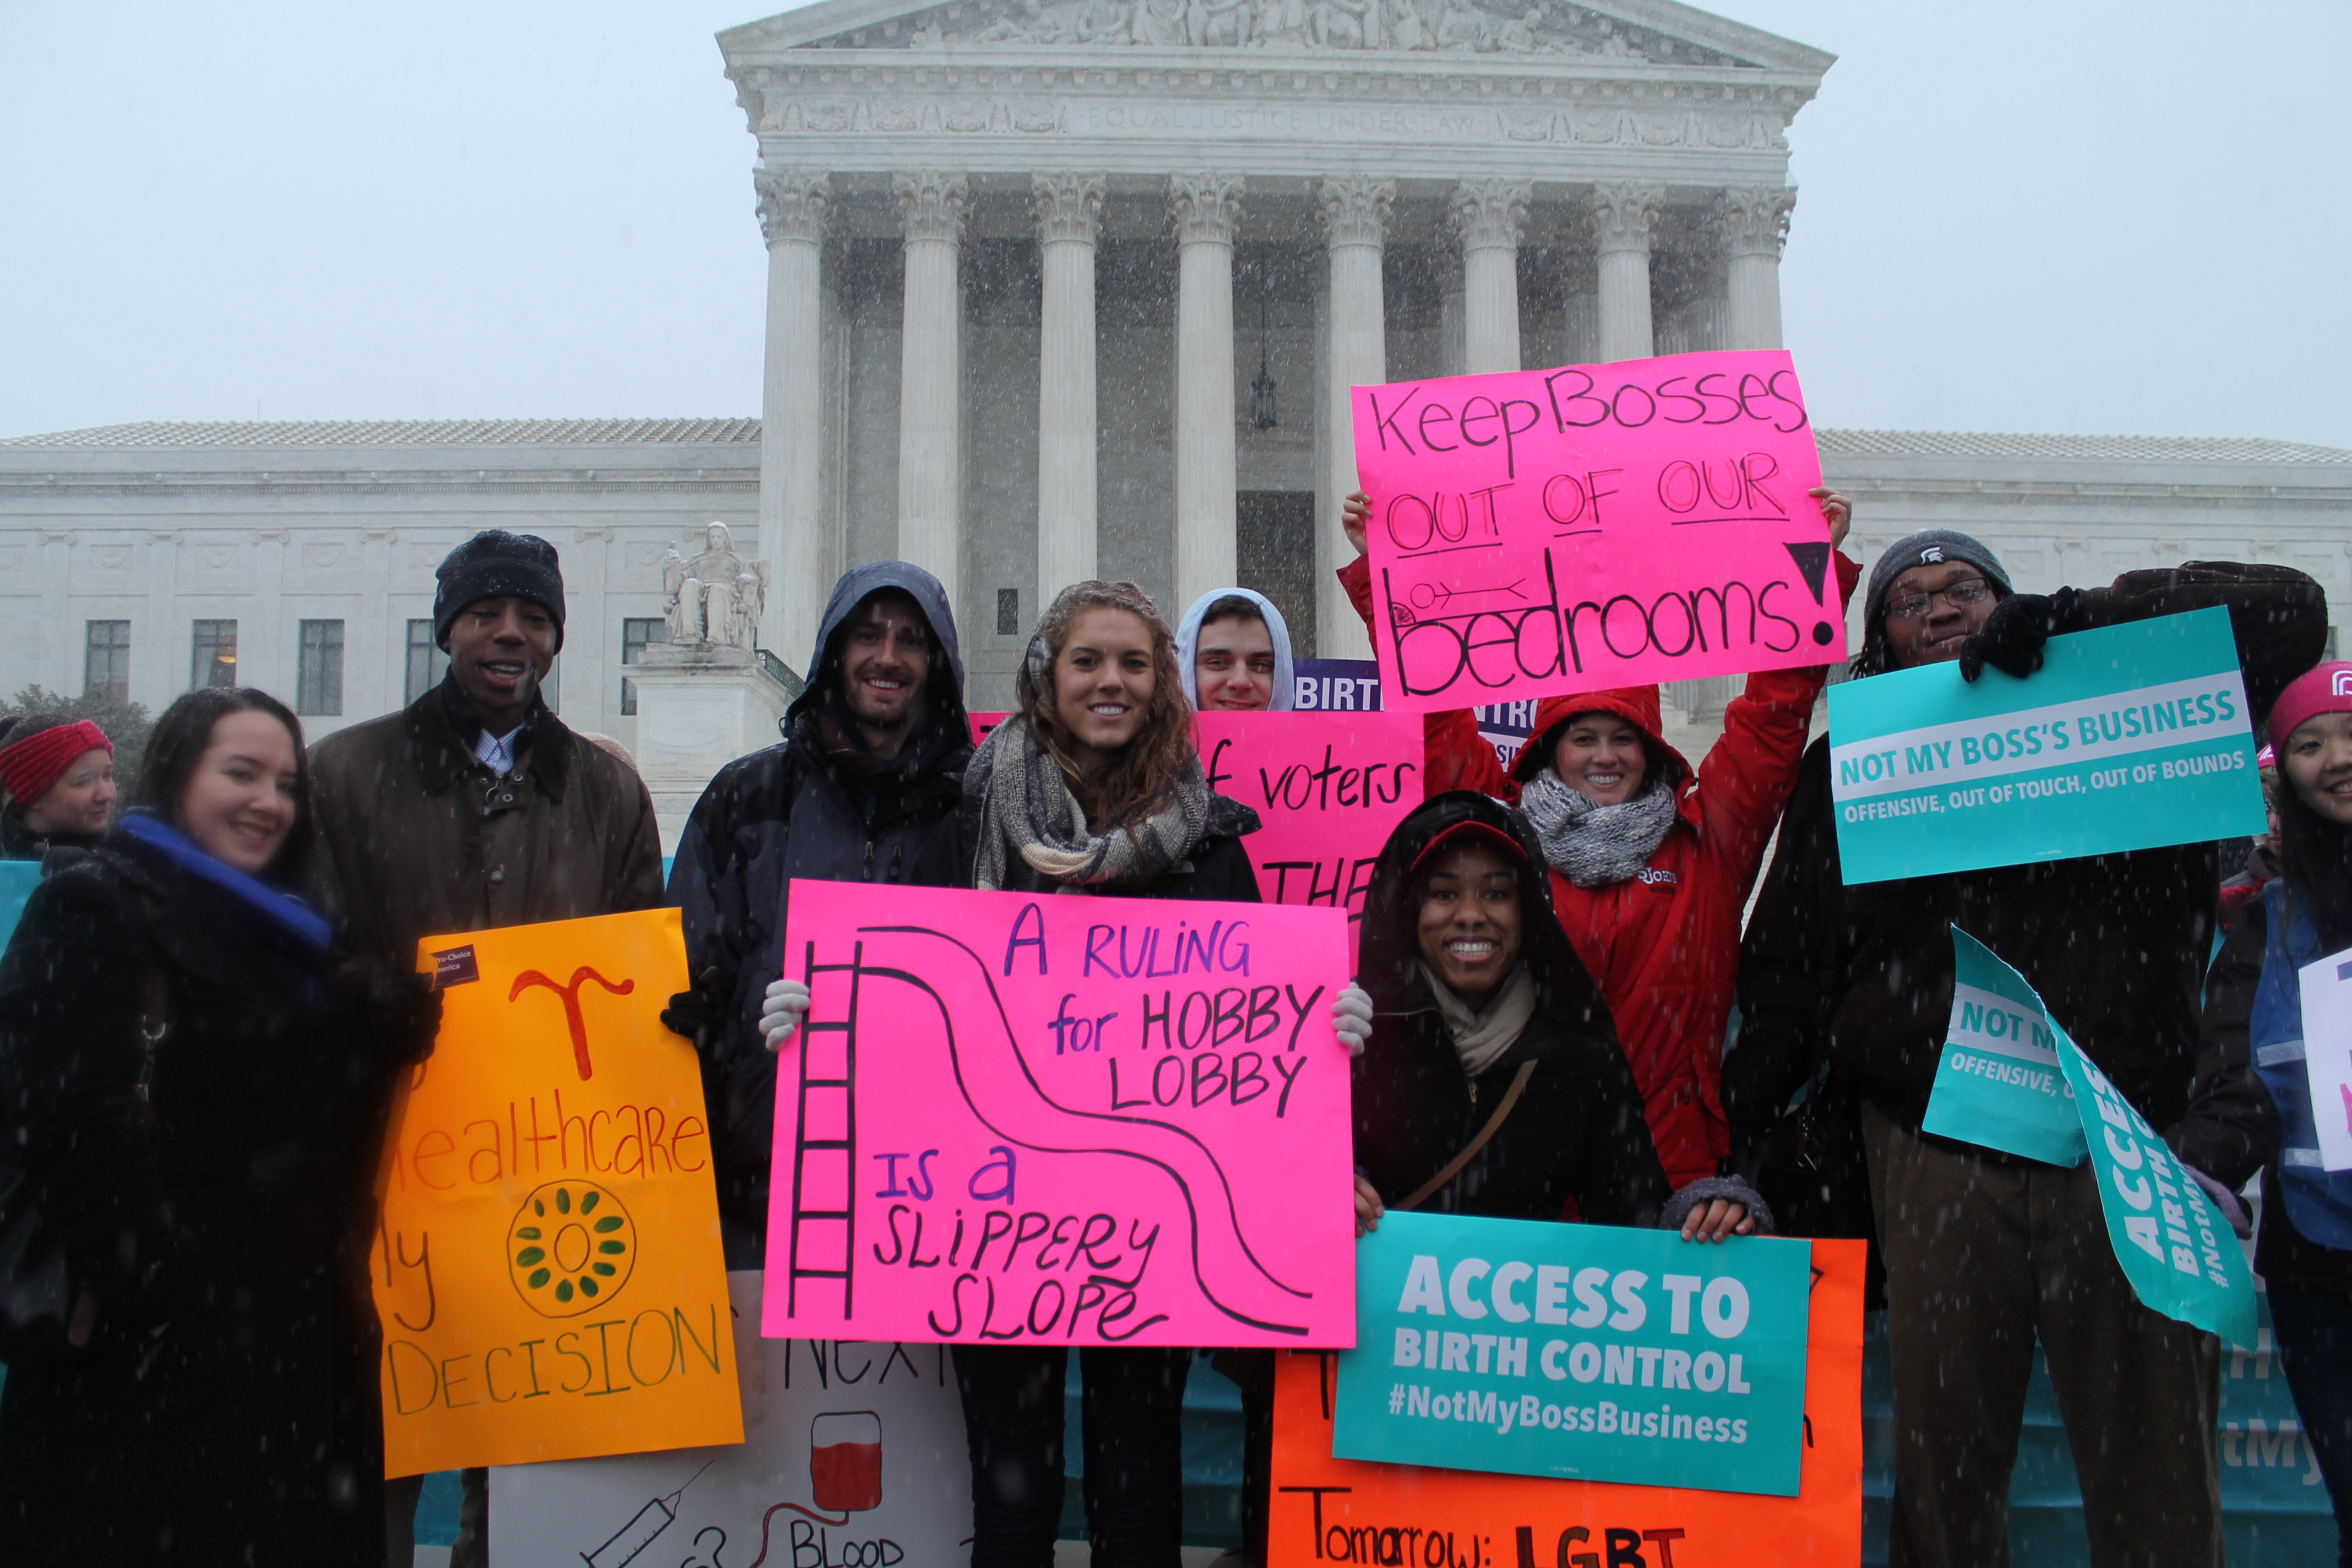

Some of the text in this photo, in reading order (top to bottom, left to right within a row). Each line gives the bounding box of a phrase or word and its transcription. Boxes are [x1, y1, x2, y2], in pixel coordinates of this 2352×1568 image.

[1370, 386, 1540, 478] Keep
[1387, 452, 1787, 550] OUT OF OUR
[1295, 677, 1385, 711] BIRT
[1839, 750, 1898, 787] NOT
[1904, 739, 1952, 774] MY
[2077, 689, 2236, 747] BUSINESS
[1259, 744, 1417, 811] voters
[1844, 750, 2245, 824] OFFENSIVE, OUT OF TOUCH, OUT OF BOUNDS
[1004, 902, 1048, 977] A
[1047, 983, 1325, 1055] for HOBBY
[1960, 1001, 2056, 1052] NOT M
[1109, 1053, 1308, 1119] LOBBY
[1951, 1052, 2058, 1097] OFFENSIVE,
[873, 1149, 940, 1201] IS
[2143, 1145, 2200, 1278] BIRTH
[1397, 1255, 1751, 1339] ACCESS TO
[388, 1303, 721, 1416] DECISION
[1393, 1327, 1751, 1395] BIRTH CONTROL
[1388, 1382, 1748, 1444] #NotMyBossBusiness
[790, 1519, 903, 1568] BLOOD
[1516, 1525, 1686, 1568] LGBT
